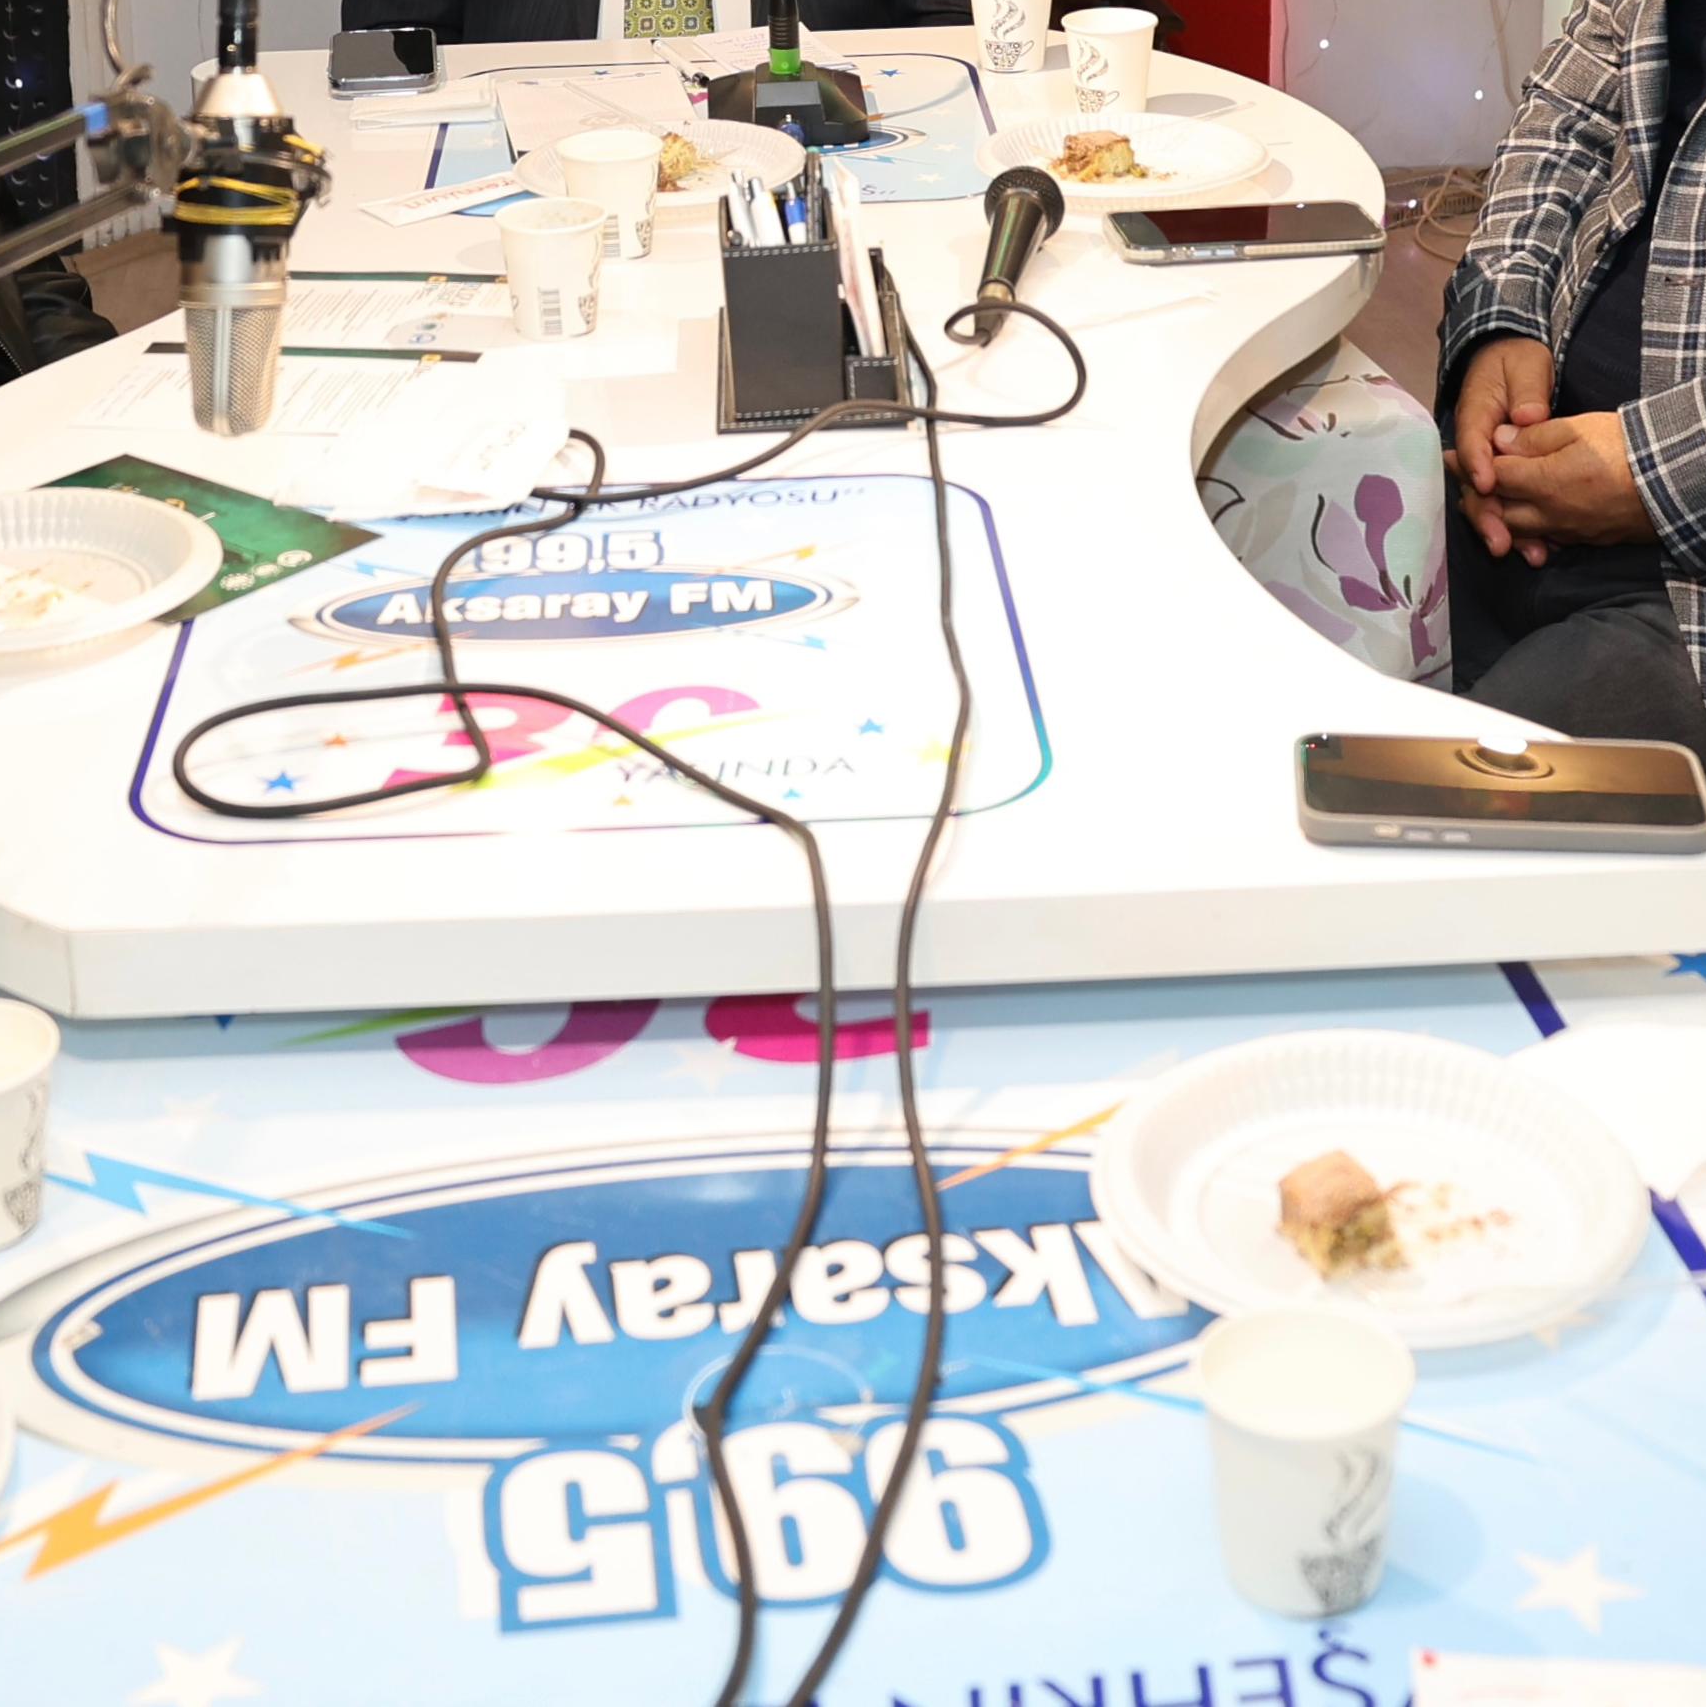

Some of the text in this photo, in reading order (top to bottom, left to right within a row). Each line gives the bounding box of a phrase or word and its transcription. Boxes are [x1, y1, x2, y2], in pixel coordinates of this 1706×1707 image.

[376, 579, 775, 627] Aksaray FM
[191, 1274, 460, 1402] FM
